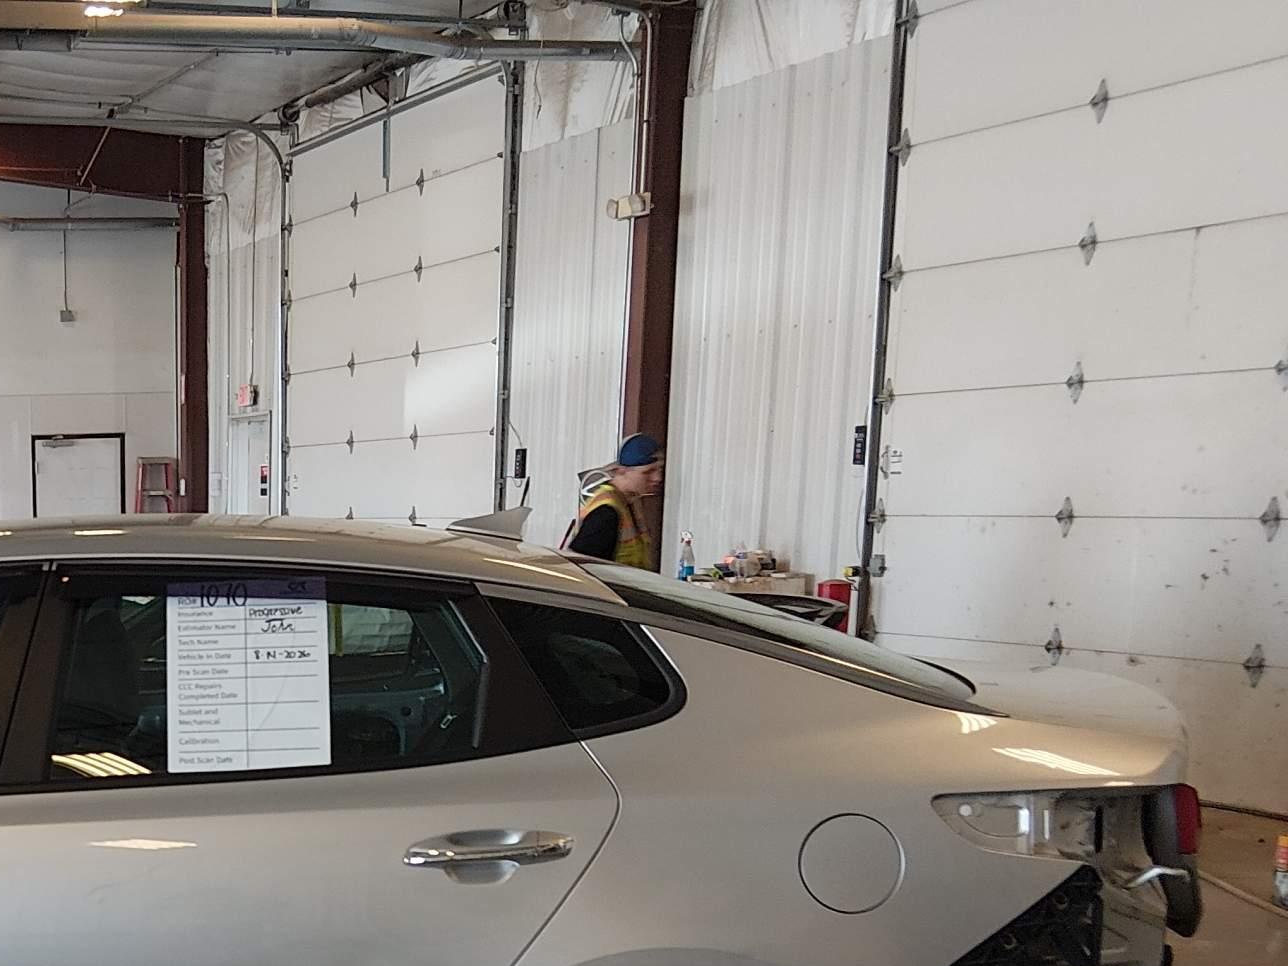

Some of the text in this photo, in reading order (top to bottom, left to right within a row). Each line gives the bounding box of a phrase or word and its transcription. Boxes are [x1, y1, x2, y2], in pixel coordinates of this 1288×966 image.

[195, 682, 222, 691] Repairs
[178, 691, 238, 700] Completed Date
[178, 718, 221, 726] Mechanical
[178, 737, 220, 745] Calibration
[216, 755, 233, 763] Date
